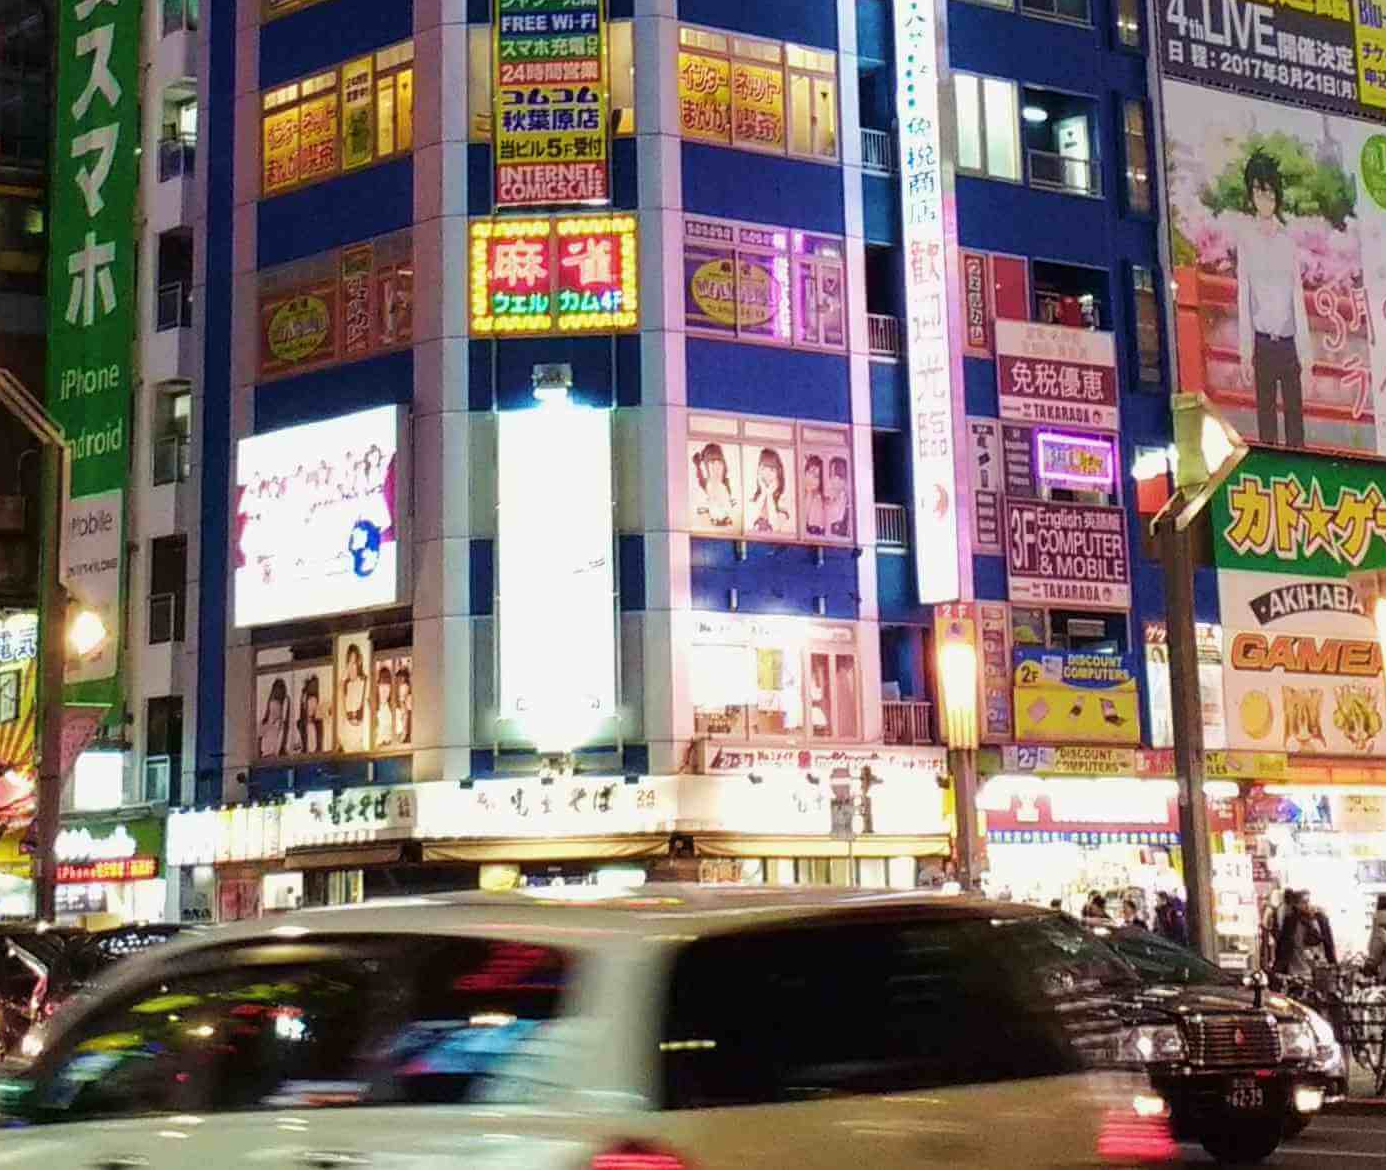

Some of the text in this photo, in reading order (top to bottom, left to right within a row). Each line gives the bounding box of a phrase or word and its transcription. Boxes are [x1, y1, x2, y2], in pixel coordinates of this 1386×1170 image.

[500, 11, 598, 33] FREE Wi-Fi
[500, 60, 599, 83] 24時間営業
[500, 87, 599, 106] コムコム
[501, 108, 600, 133] 秋葉原店
[499, 136, 603, 159] 当ビル5F受付
[493, 239, 618, 286] 麻雀
[59, 362, 120, 401] iPhone
[68, 416, 124, 463] ndroid
[1038, 506, 1082, 529] English
[1012, 510, 1037, 569] 3F
[1038, 528, 1124, 558] COMPUTER
[1039, 553, 1125, 580] & MOBILE
[1067, 653, 1123, 669] DISCOUNT
